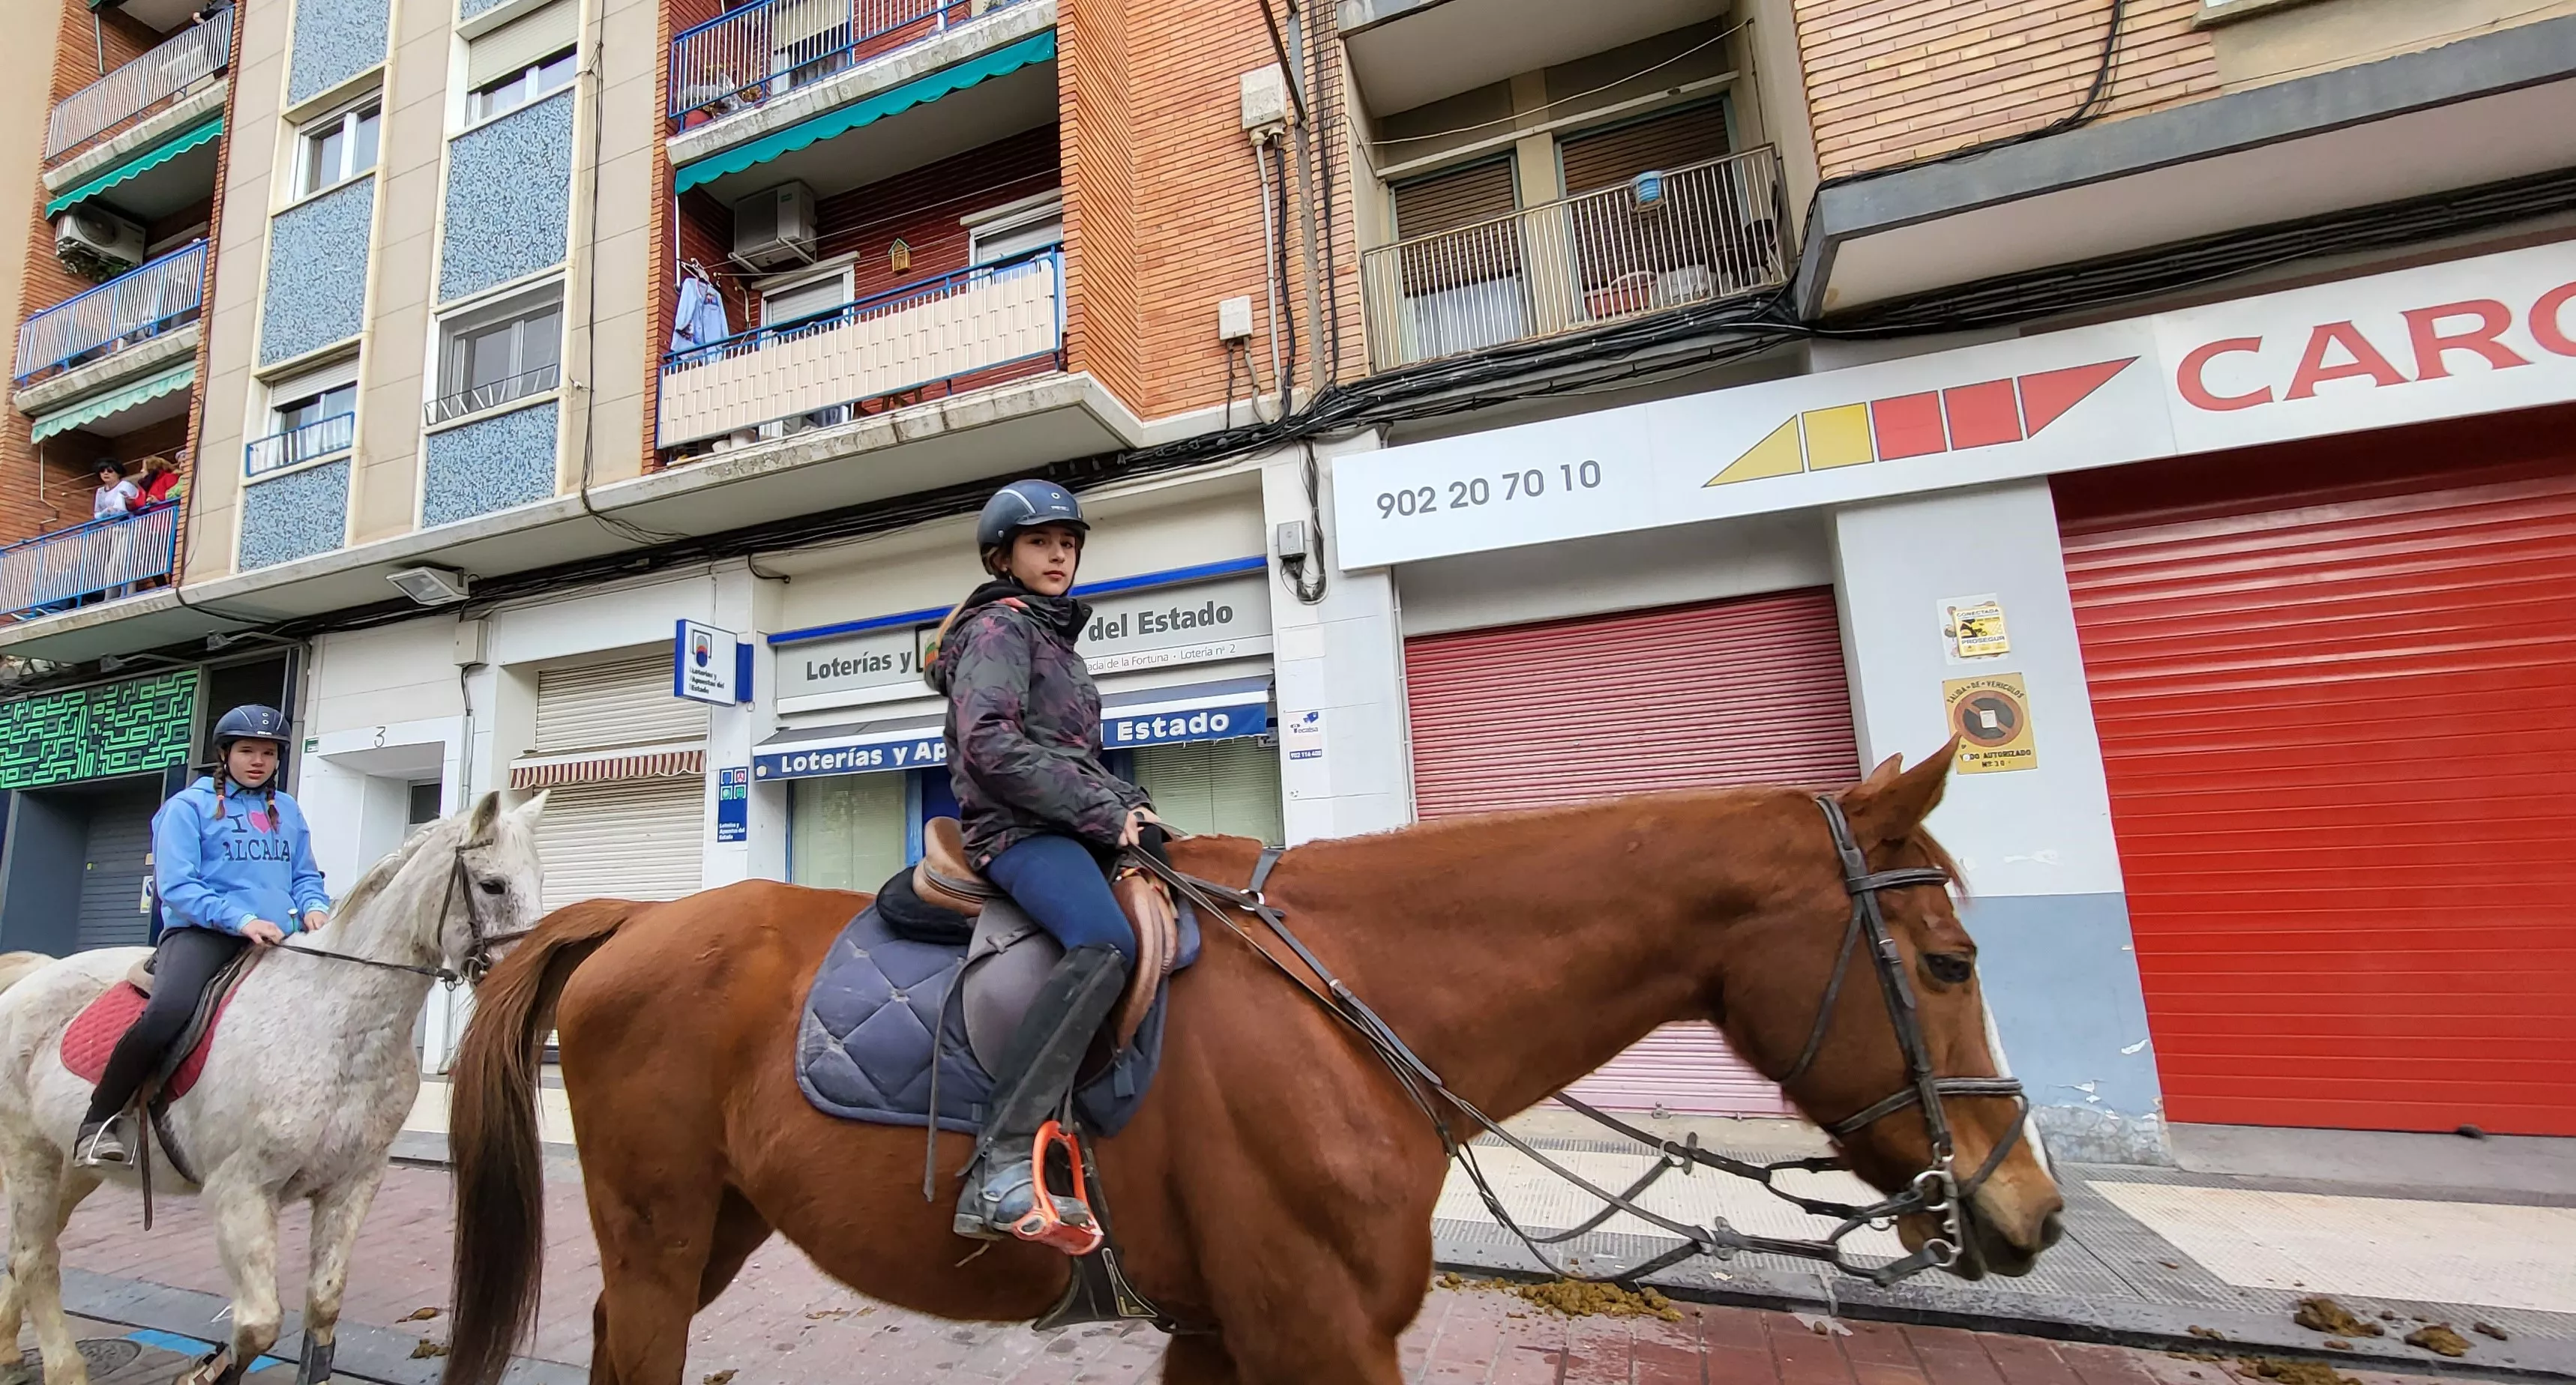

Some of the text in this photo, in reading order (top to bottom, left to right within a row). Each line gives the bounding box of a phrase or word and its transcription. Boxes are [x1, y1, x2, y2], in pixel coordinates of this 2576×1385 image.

[1377, 460, 1601, 519] 902 20 70 10
[1957, 609, 1999, 618] CONECTADA
[807, 601, 1233, 681] Loterías y del Estado
[1961, 636, 2005, 645] PROSEGUR
[1107, 659, 1119, 669] de
[1122, 657, 1129, 666] la
[1132, 654, 1169, 666] Fortuna
[1180, 646, 1213, 660] Lotería
[1230, 644, 1236, 654] 2
[1946, 687, 1967, 704] SALIDA
[374, 726, 386, 748] 3
[781, 748, 883, 773] Loterías
[892, 746, 908, 766] y
[1117, 712, 1230, 741] Estado
[1960, 749, 2031, 761] VDO AUTORIZADO
[226, 814, 247, 833] I
